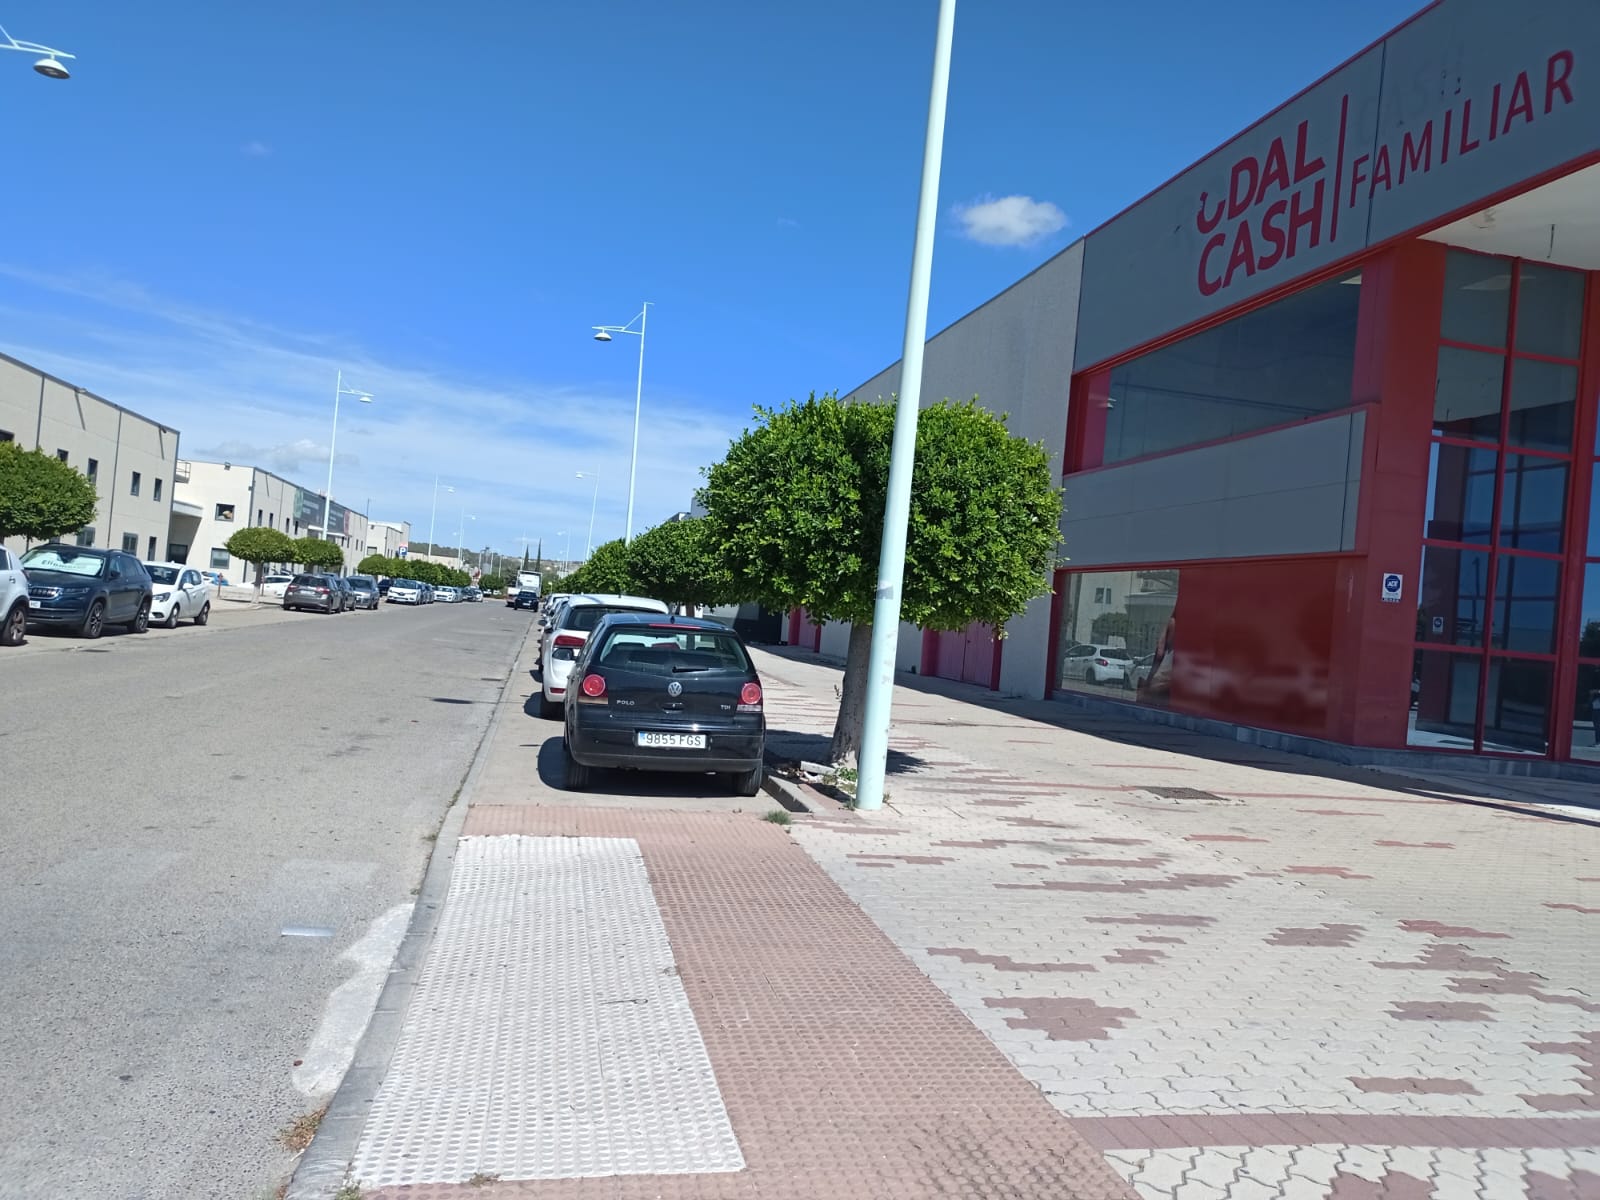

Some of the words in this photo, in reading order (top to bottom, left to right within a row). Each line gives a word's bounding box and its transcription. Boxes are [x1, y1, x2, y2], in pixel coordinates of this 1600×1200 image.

[1350, 49, 1574, 208] FAMILIAR
[1198, 178, 1325, 296] CASH
[646, 734, 676, 745] 9855
[679, 735, 702, 746] FGS
